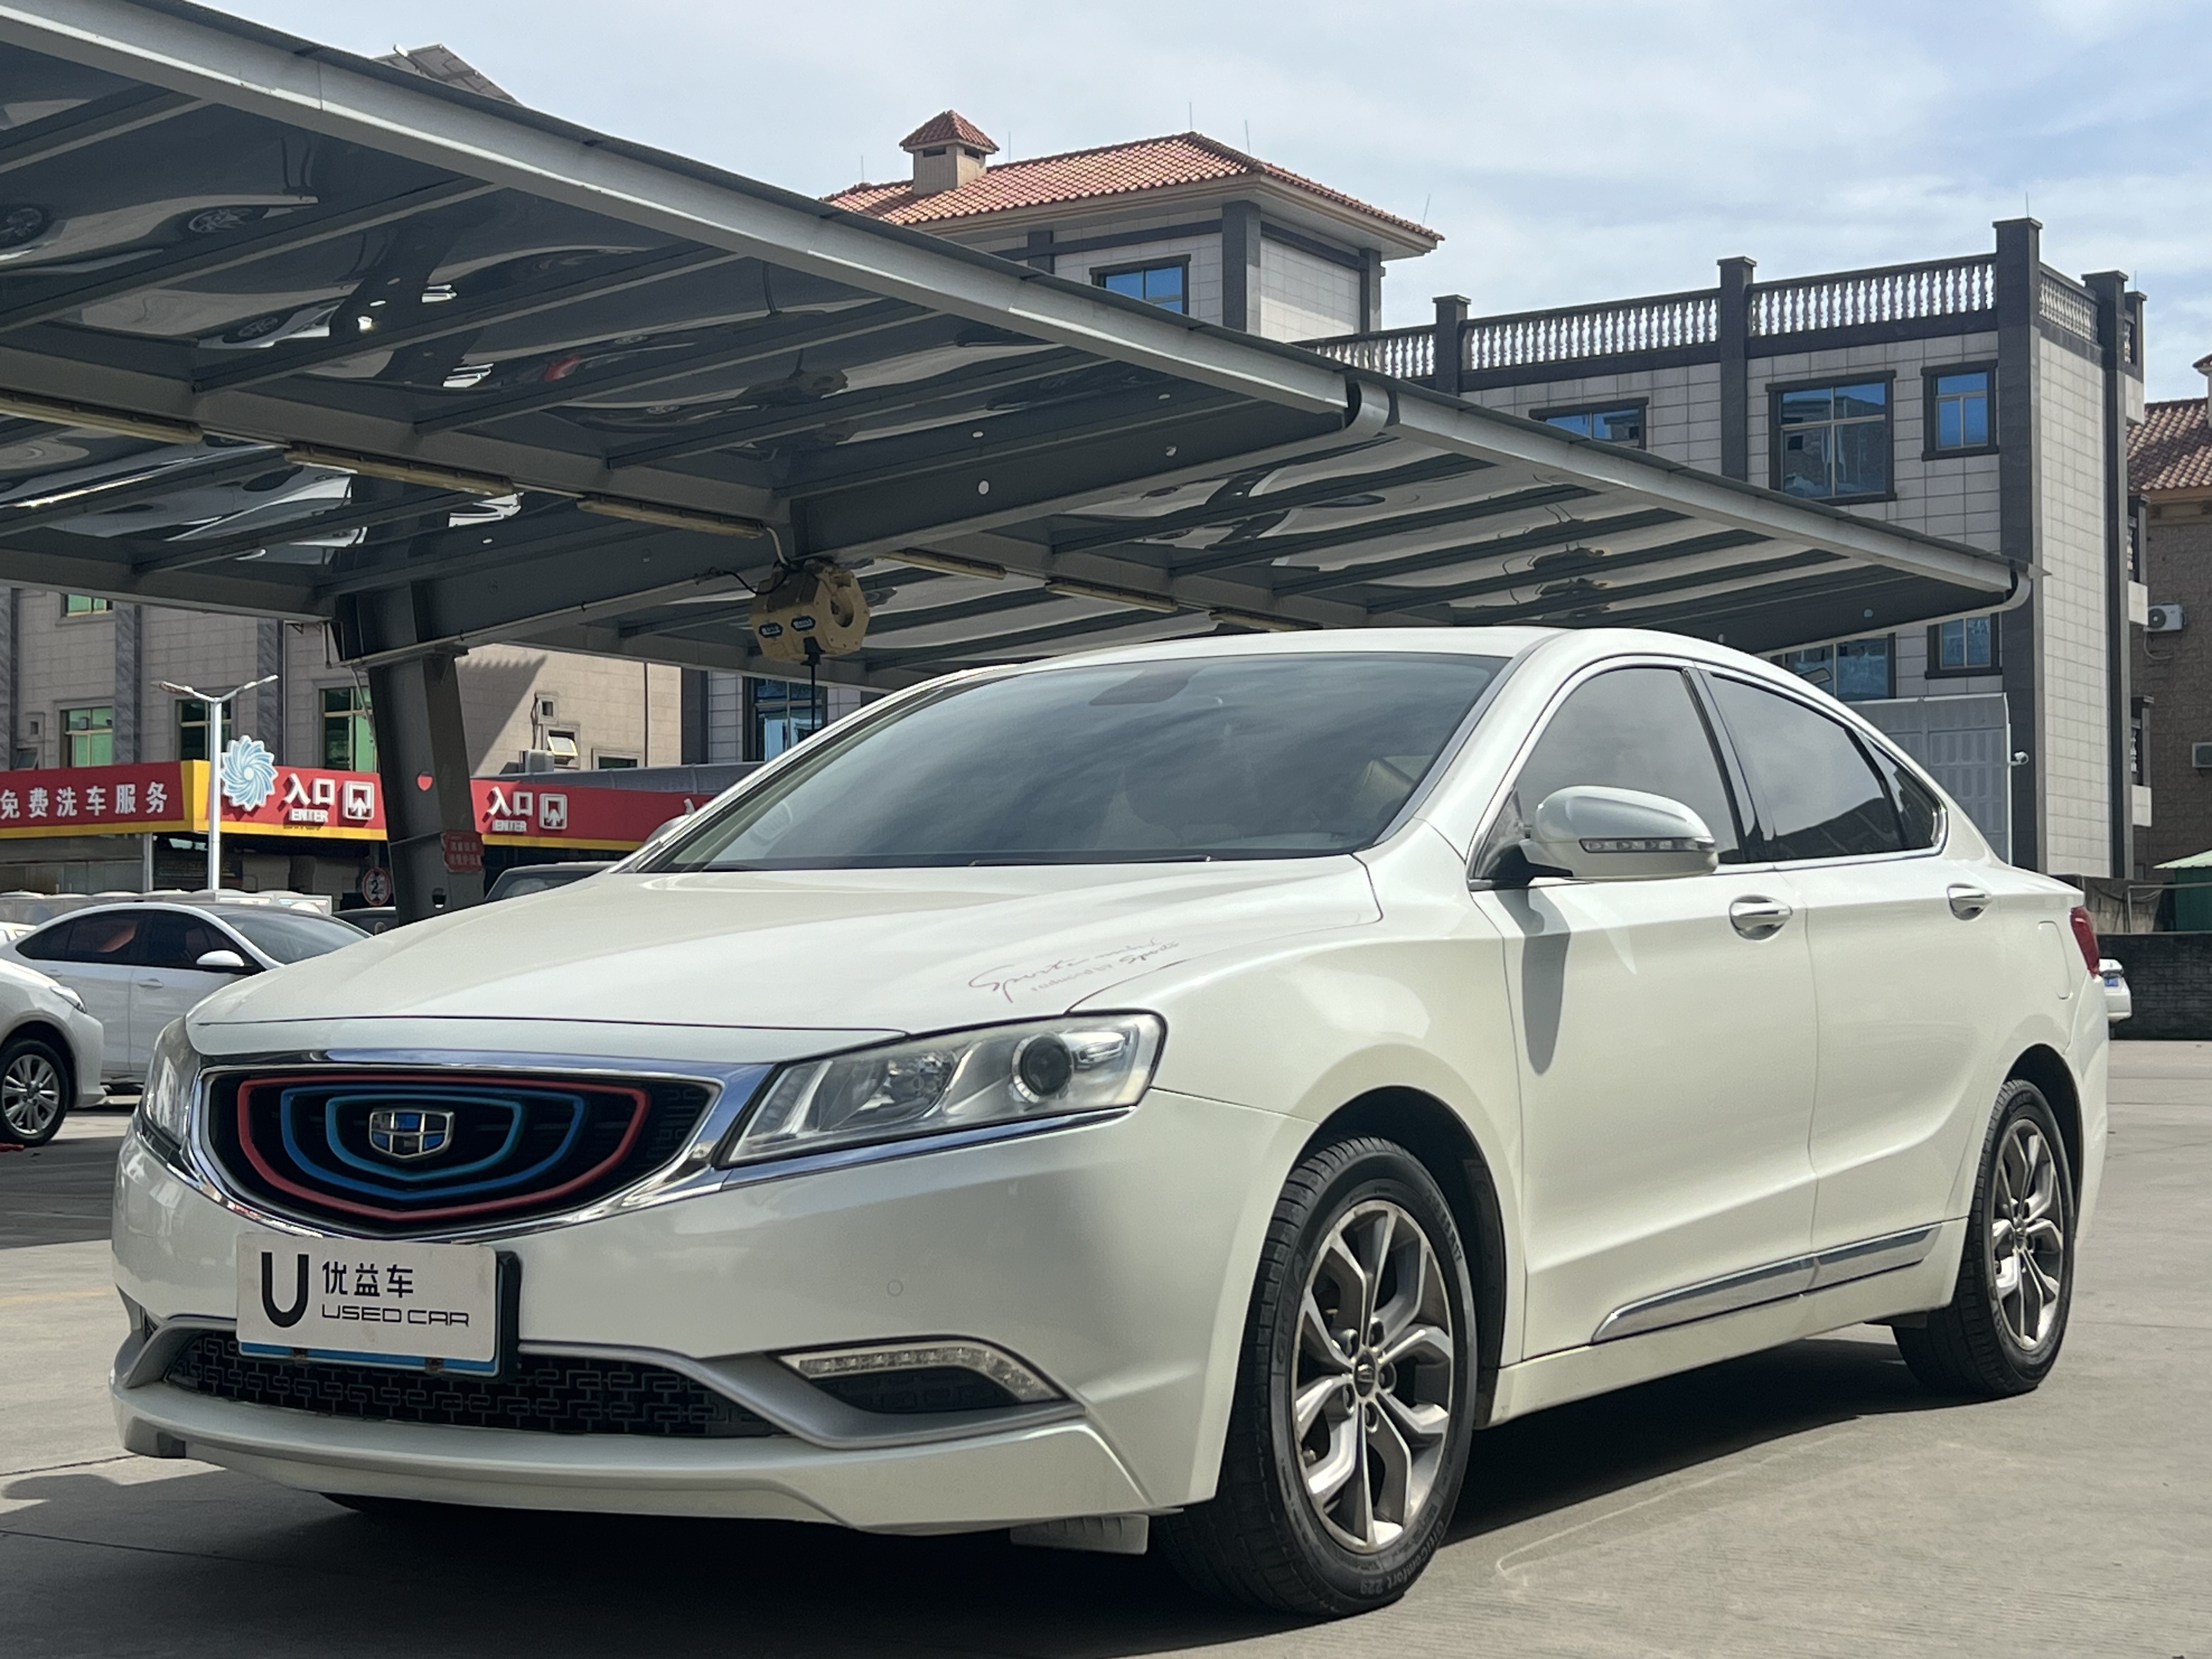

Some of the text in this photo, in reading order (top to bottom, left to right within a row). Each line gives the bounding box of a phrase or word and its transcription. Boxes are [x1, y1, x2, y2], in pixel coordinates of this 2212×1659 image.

[1, 781, 167, 819] 免费洗车服务
[284, 773, 335, 805] 入口
[487, 786, 533, 816] 入口
[289, 808, 329, 822] ENTER
[262, 1251, 309, 1328] U
[322, 1261, 413, 1298] 优益车
[322, 1304, 470, 1327] USED CAR
